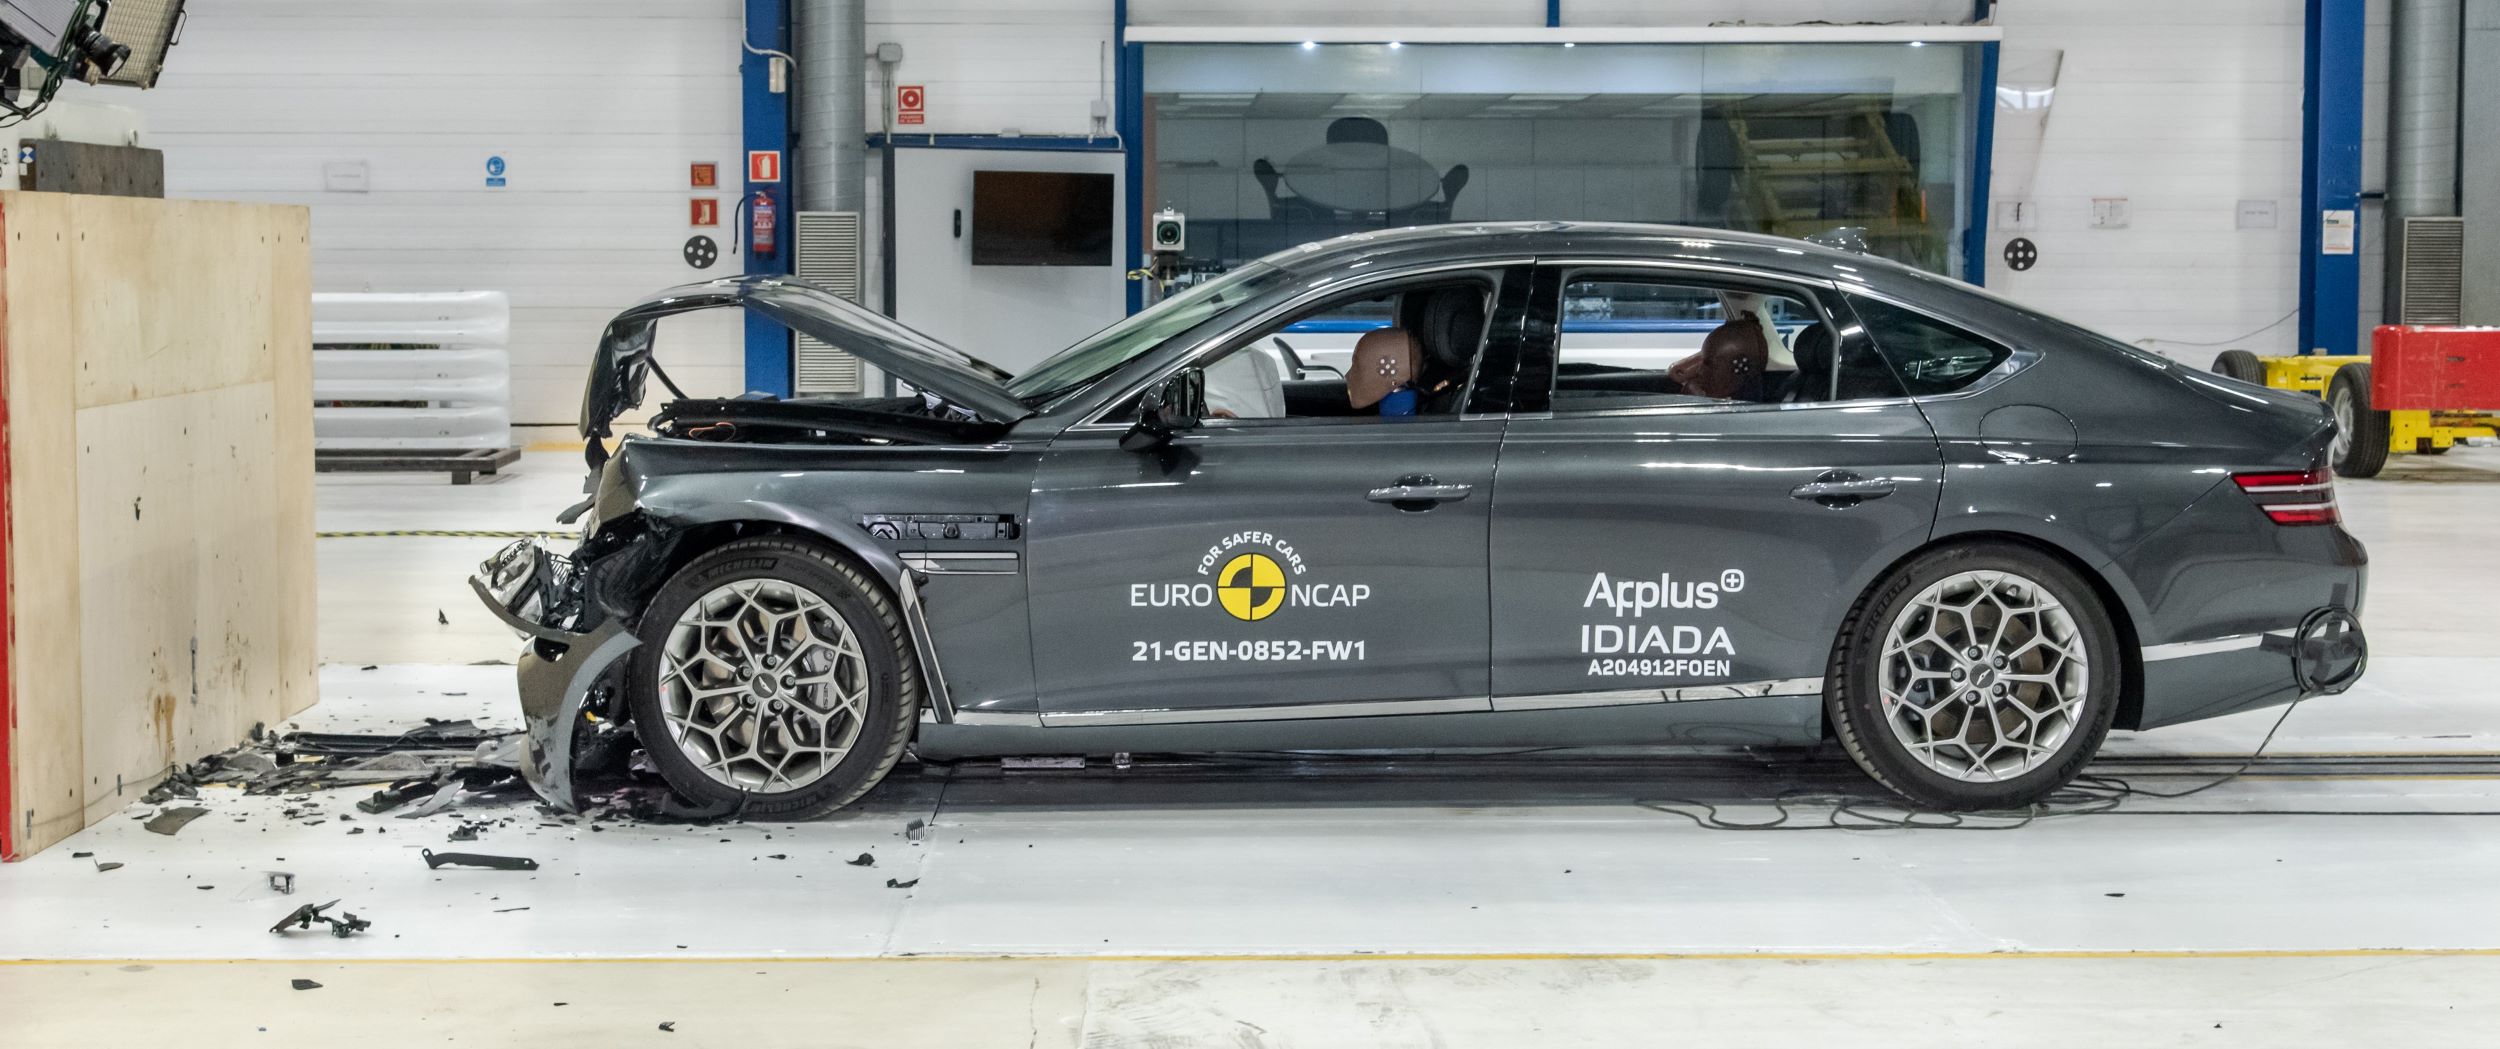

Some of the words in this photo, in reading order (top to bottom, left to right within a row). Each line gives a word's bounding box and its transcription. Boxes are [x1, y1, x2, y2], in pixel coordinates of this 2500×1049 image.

[1197, 545, 1224, 576] FOR
[1222, 530, 1273, 550] SAFER
[1275, 539, 1307, 576] CARS
[708, 557, 776, 578] MICHELIN
[1130, 583, 1213, 607] EURO
[1291, 583, 1371, 608] NCAP
[1132, 640, 1365, 662] 21-GEN-0852-FW1
[1581, 624, 1736, 656] IDIADA
